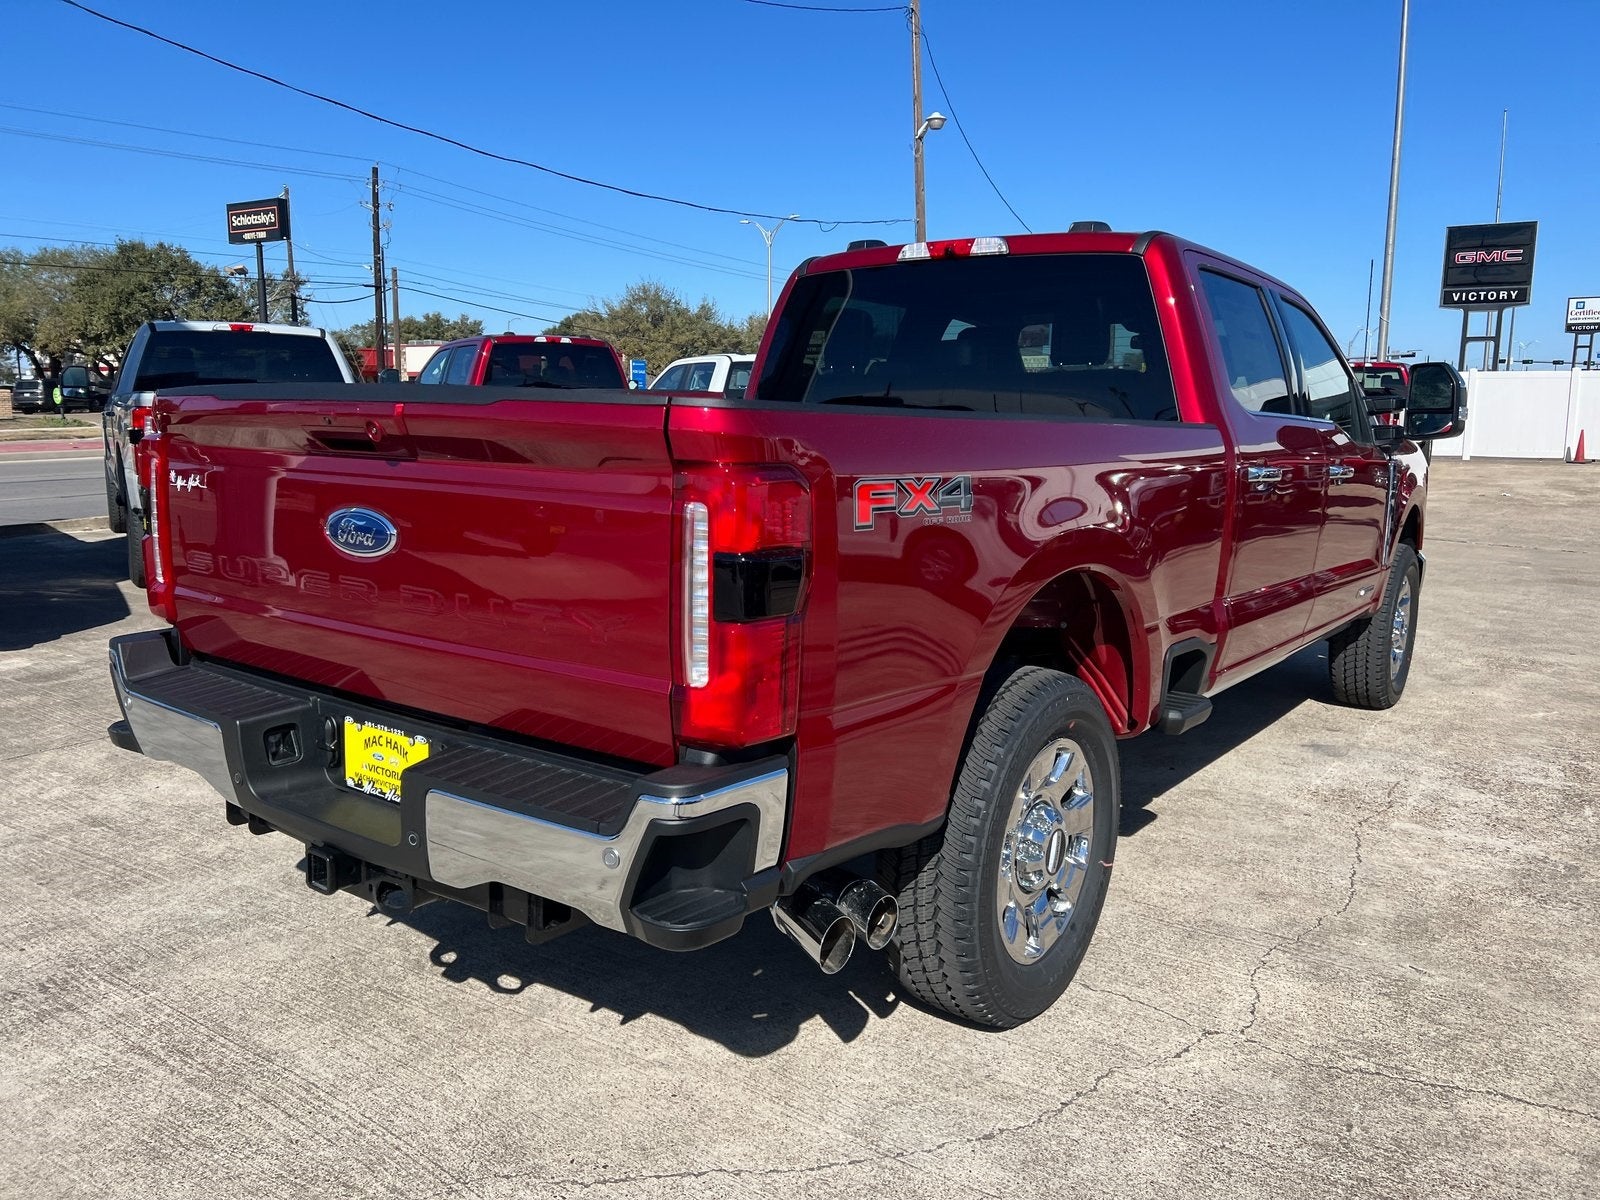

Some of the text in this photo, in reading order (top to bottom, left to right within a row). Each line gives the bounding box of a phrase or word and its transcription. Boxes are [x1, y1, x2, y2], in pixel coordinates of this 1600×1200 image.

[231, 212, 275, 226] Schlotzsky's
[1455, 249, 1524, 264] GMC
[1452, 290, 1519, 302] VICTORY
[854, 475, 973, 531] FX4
[337, 517, 376, 547] Ford
[185, 549, 634, 644] SUPER DUTY
[364, 735, 383, 750] MAC
[386, 736, 408, 762] HAIK
[354, 771, 401, 791] MACHAIKVICTOR
[367, 763, 401, 781] VICTORI
[363, 780, 401, 803] Mac Ha
